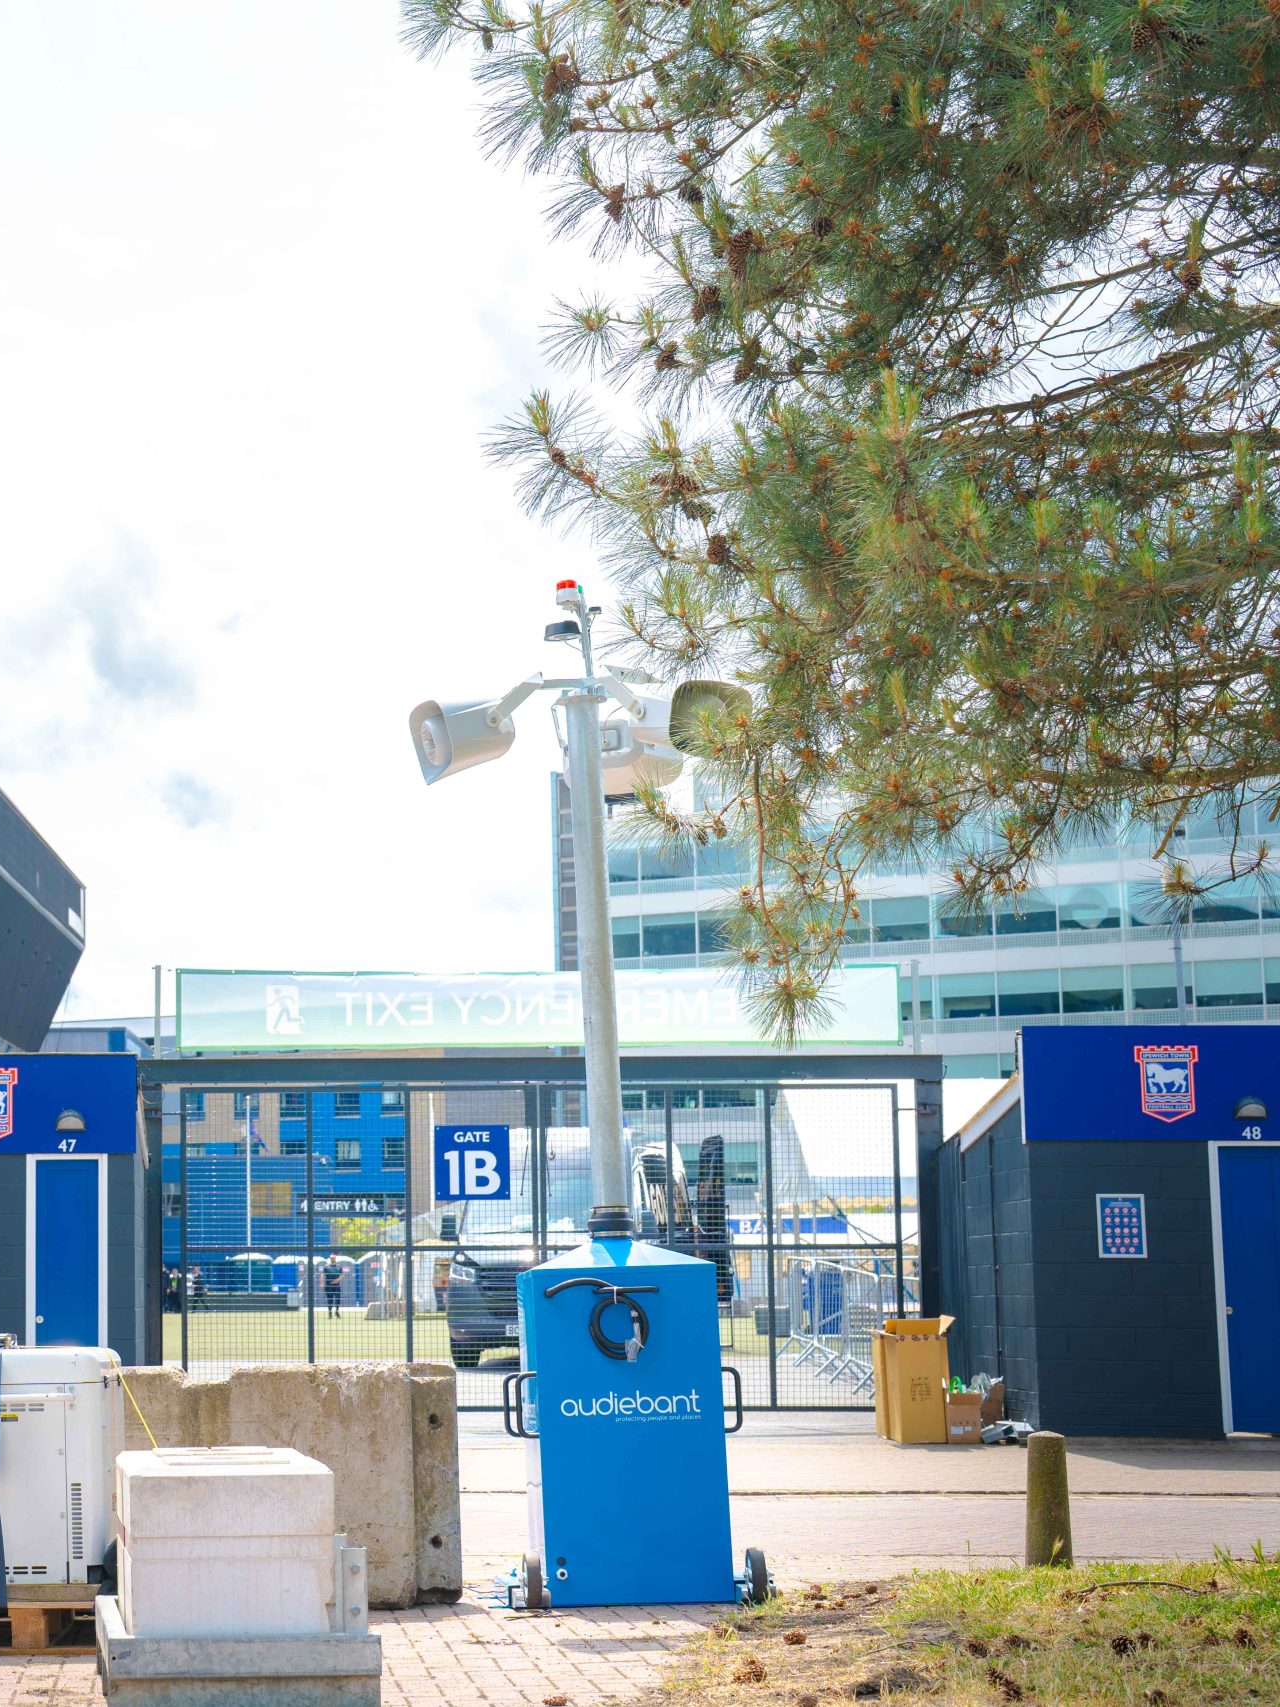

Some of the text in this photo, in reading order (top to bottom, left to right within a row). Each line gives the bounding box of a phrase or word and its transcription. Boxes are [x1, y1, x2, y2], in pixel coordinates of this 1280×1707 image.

[453, 1131, 491, 1143] GATE
[1241, 1126, 1262, 1140] 48
[58, 1139, 77, 1152] 47
[443, 1150, 501, 1195] 1B
[314, 1200, 351, 1211] ENTRY
[560, 1389, 701, 1416] audiebant
